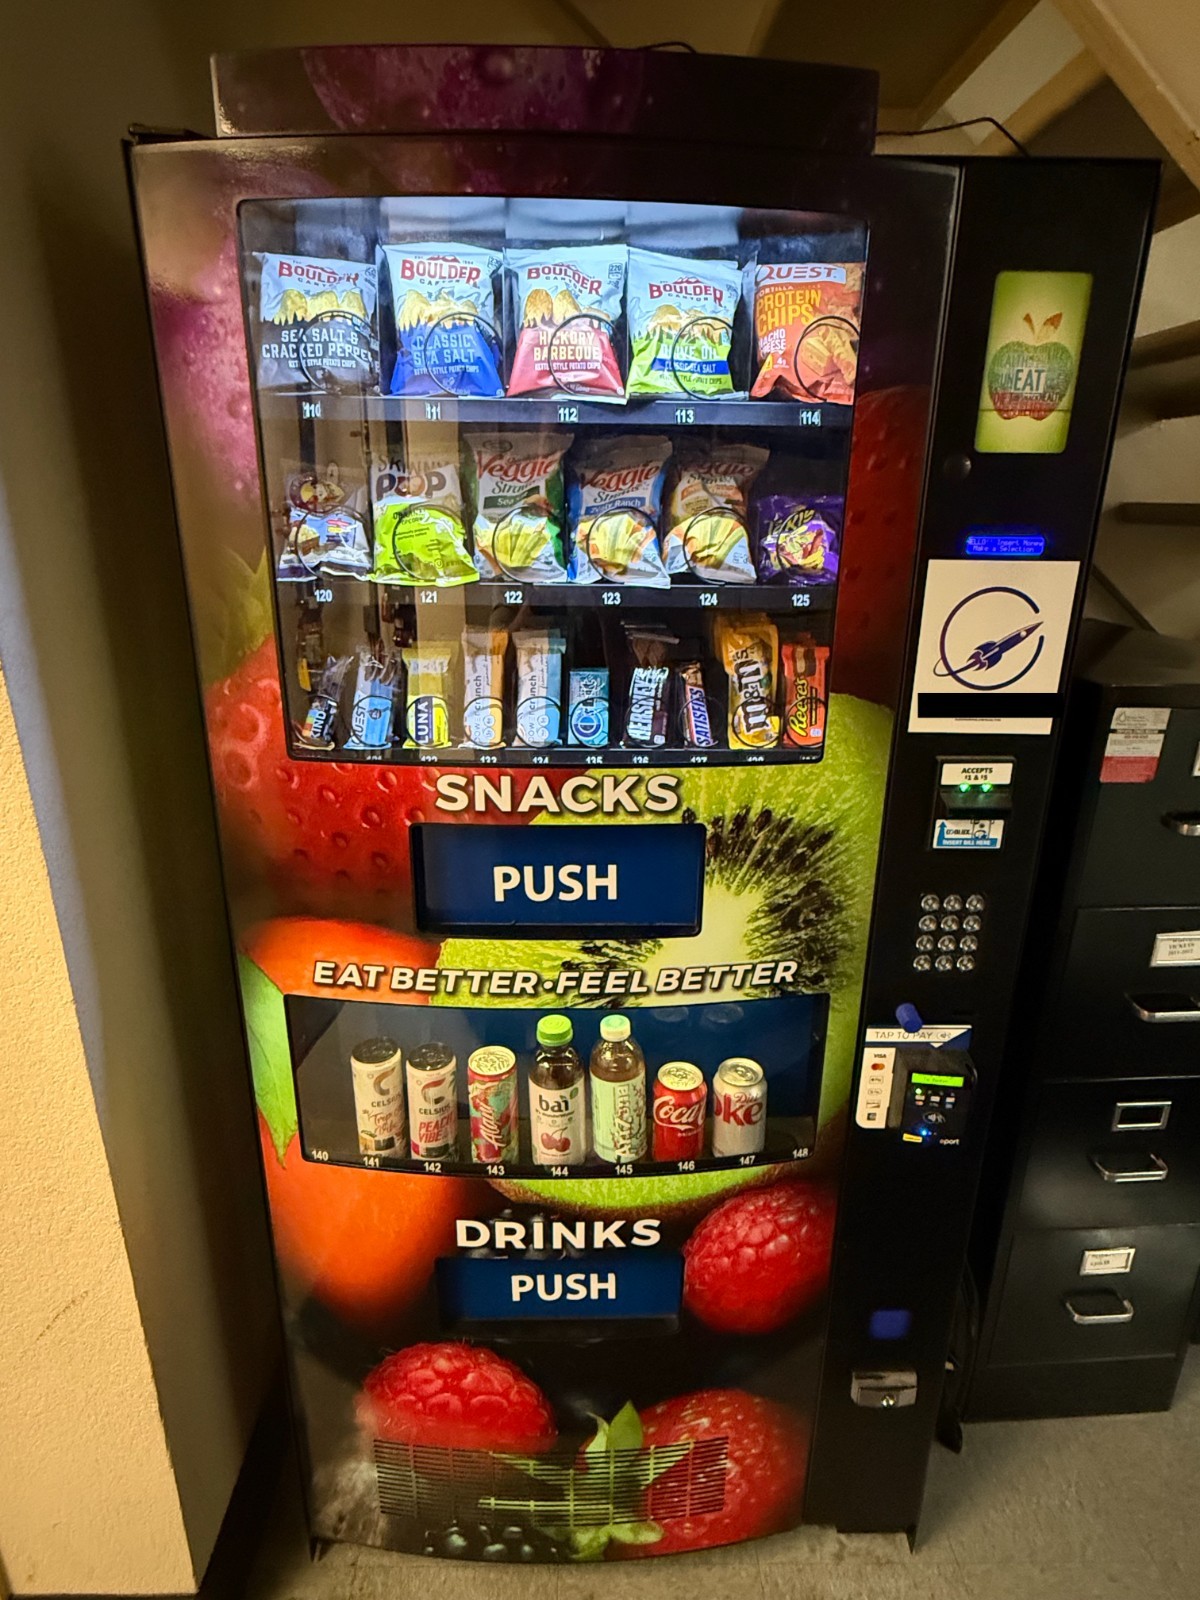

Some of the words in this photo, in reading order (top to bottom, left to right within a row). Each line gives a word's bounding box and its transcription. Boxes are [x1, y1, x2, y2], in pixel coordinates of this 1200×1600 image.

[401, 258, 481, 289] BOULDER
[758, 264, 837, 280] QUEST
[527, 264, 604, 297] BOULDER
[648, 282, 725, 308] BOULDER
[757, 289, 822, 318] PROTEIN
[757, 303, 815, 336] CHIPS
[281, 328, 307, 343] SEA
[312, 327, 345, 342] SALT
[540, 330, 595, 346] HICKORY
[261, 342, 324, 359] CRACKED
[443, 348, 475, 364] SALT
[533, 345, 603, 362] BARBEQUE
[702, 363, 716, 374] SALT
[1013, 368, 1046, 391] EAT
[558, 407, 577, 422] 112
[675, 409, 694, 423] 113
[801, 411, 820, 425] 114
[376, 470, 447, 503] POP
[314, 589, 332, 602] 120
[420, 591, 438, 604] 121
[504, 591, 523, 604] 122
[602, 592, 621, 605] 123
[700, 593, 718, 606] 124
[791, 594, 810, 607] 125
[310, 710, 327, 739] KIND
[416, 701, 430, 744] LUNA
[689, 687, 714, 746] SATISFIES
[435, 774, 680, 812] SNACKS
[492, 864, 618, 902] PUSH
[312, 960, 386, 989] EAT
[655, 960, 799, 992] BETTER
[875, 1031, 894, 1039] TAP
[897, 1031, 911, 1039] TO
[913, 1031, 933, 1039] PAY
[538, 1094, 570, 1113] bai
[419, 1130, 443, 1144] VIBE
[311, 1149, 329, 1161] 140
[739, 1155, 756, 1166] 147
[792, 1148, 809, 1159] 148
[362, 1156, 380, 1168] 141
[423, 1162, 442, 1173] 142
[486, 1164, 505, 1175] 143
[614, 1164, 633, 1175] 145
[677, 1160, 695, 1171] 146
[550, 1166, 569, 1176] 144
[455, 1218, 662, 1250] DRINKS
[510, 1272, 617, 1302] PUSH
